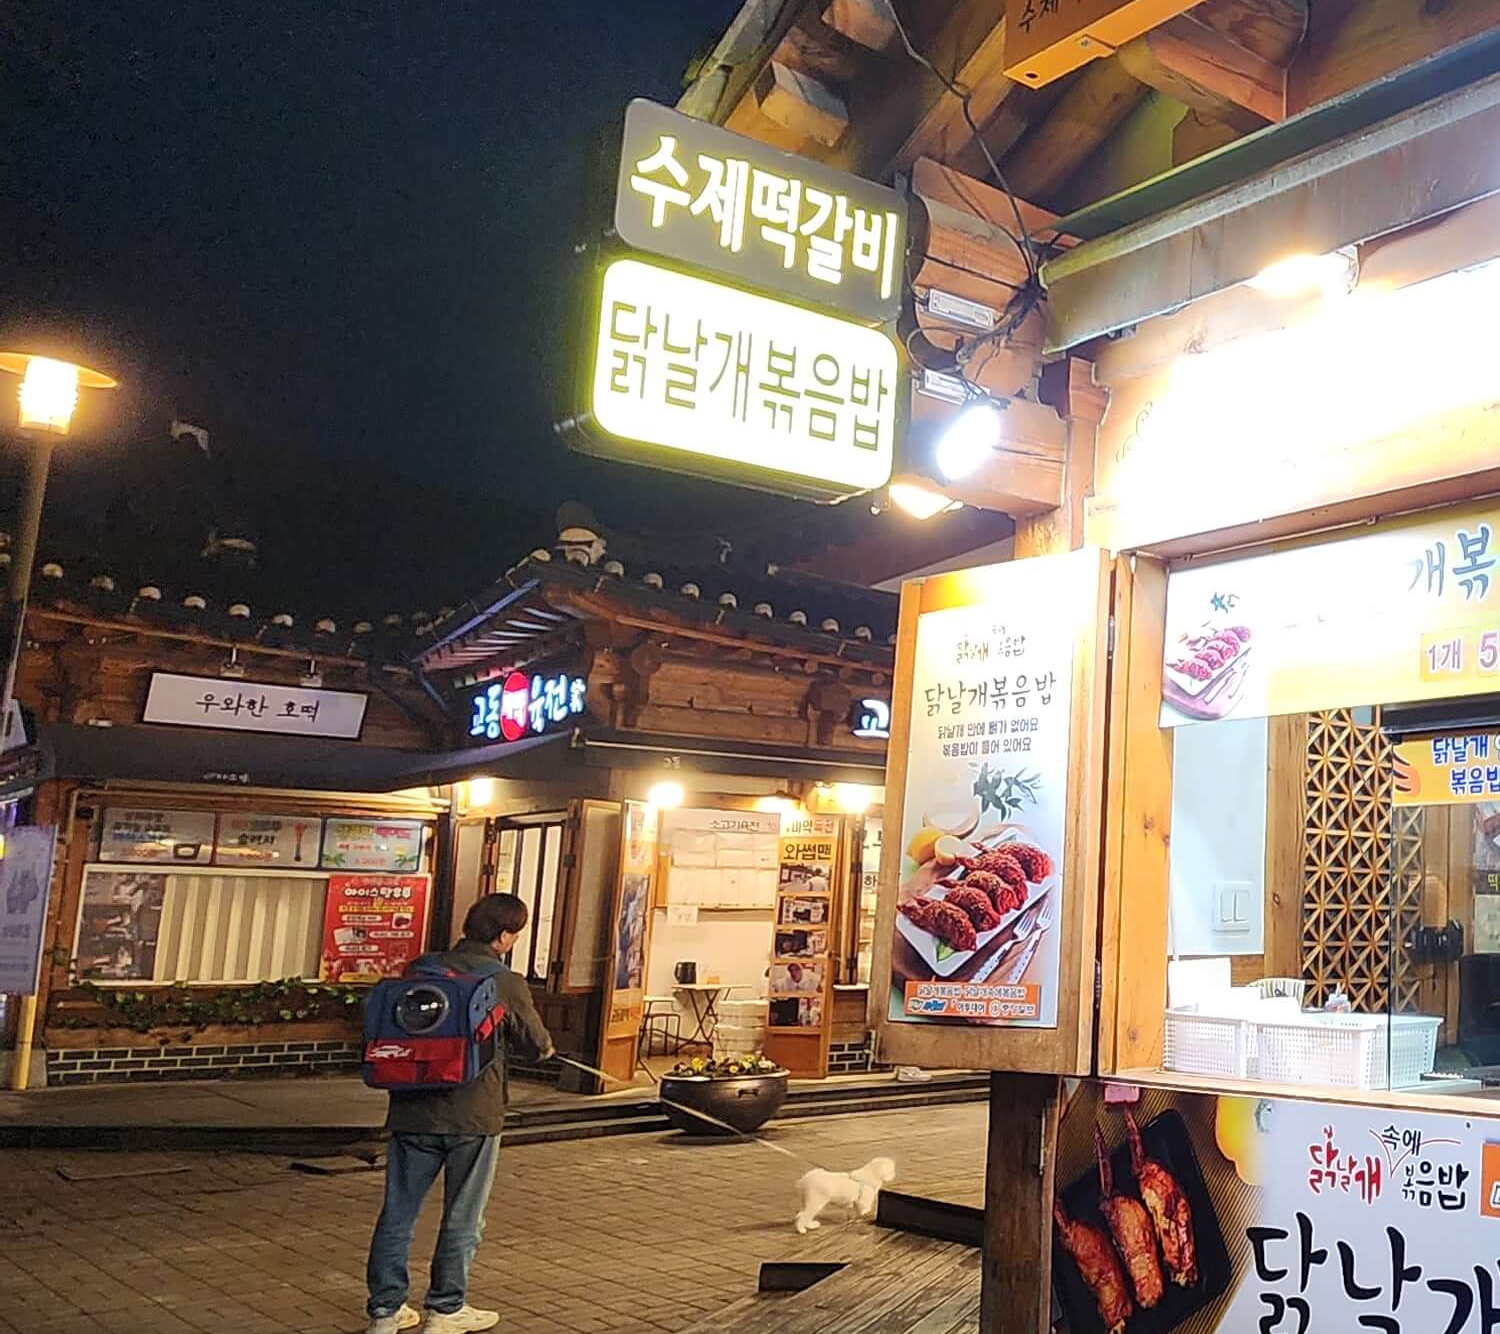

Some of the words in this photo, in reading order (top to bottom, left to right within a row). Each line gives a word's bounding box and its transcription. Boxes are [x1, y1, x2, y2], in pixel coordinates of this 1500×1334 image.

[631, 136, 898, 299] 수제떡갈비
[610, 300, 888, 452] 닭날개볶음밥
[1427, 640, 1461, 671] 1개
[196, 692, 269, 718] 우와한
[276, 701, 321, 723] 호떡
[925, 671, 1056, 717] 닭날개볶음밥
[1432, 733, 1488, 764] 닭날개
[1381, 1123, 1421, 1156] 속에
[1308, 1124, 1382, 1205] 닭날개
[1400, 1162, 1469, 1210] 볶음밥
